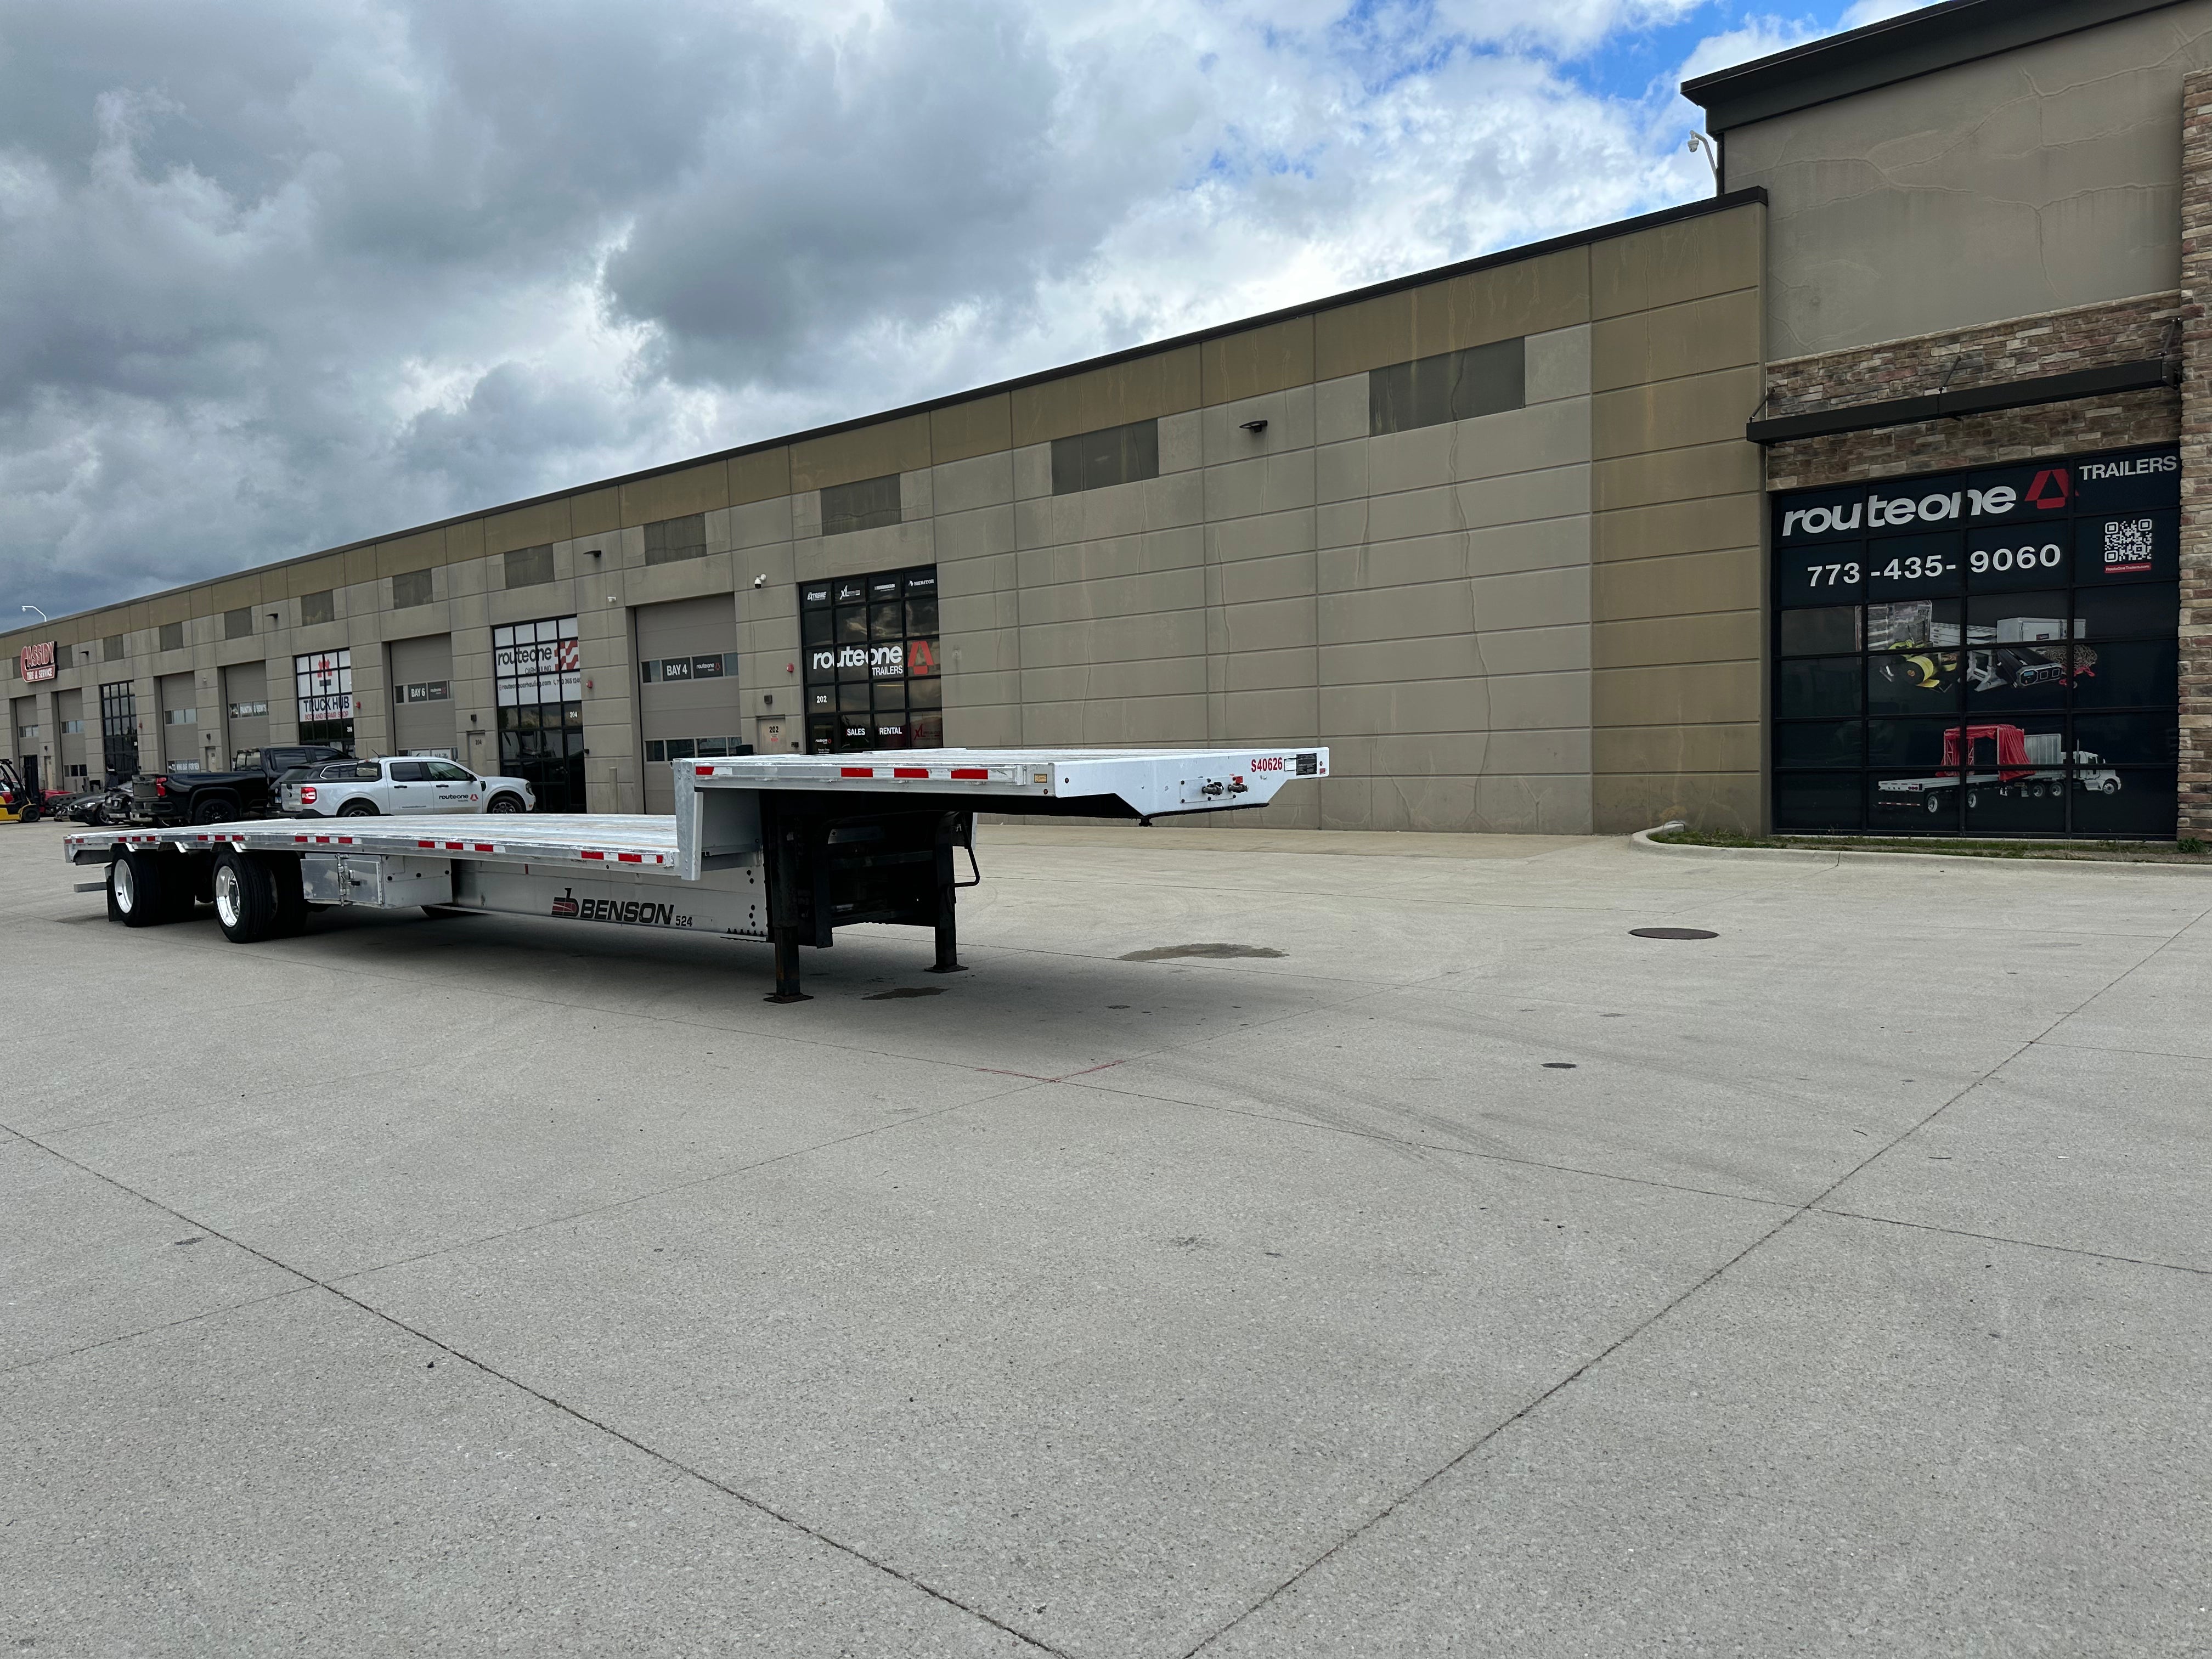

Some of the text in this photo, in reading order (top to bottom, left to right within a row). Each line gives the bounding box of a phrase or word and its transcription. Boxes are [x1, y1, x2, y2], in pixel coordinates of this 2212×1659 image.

[2079, 456, 2177, 480] TRAILERS
[1782, 486, 2016, 537] routeone
[1807, 562, 1860, 587] 773
[1970, 544, 2061, 573] 9060
[808, 592, 827, 601] EXTREME
[21, 641, 54, 670] CASSIDY
[498, 647, 552, 665] routeone
[813, 646, 902, 669] routeone
[525, 665, 551, 674] CARHULING
[667, 664, 687, 676] BAY 4
[872, 665, 902, 675] TRAILERS
[411, 687, 425, 697] BAY 6
[303, 696, 349, 712] TRUCK HUB
[879, 727, 902, 735] RENTAL
[1251, 757, 1283, 772] S40626
[580, 899, 674, 925] BENSON
[675, 915, 692, 927] 524
